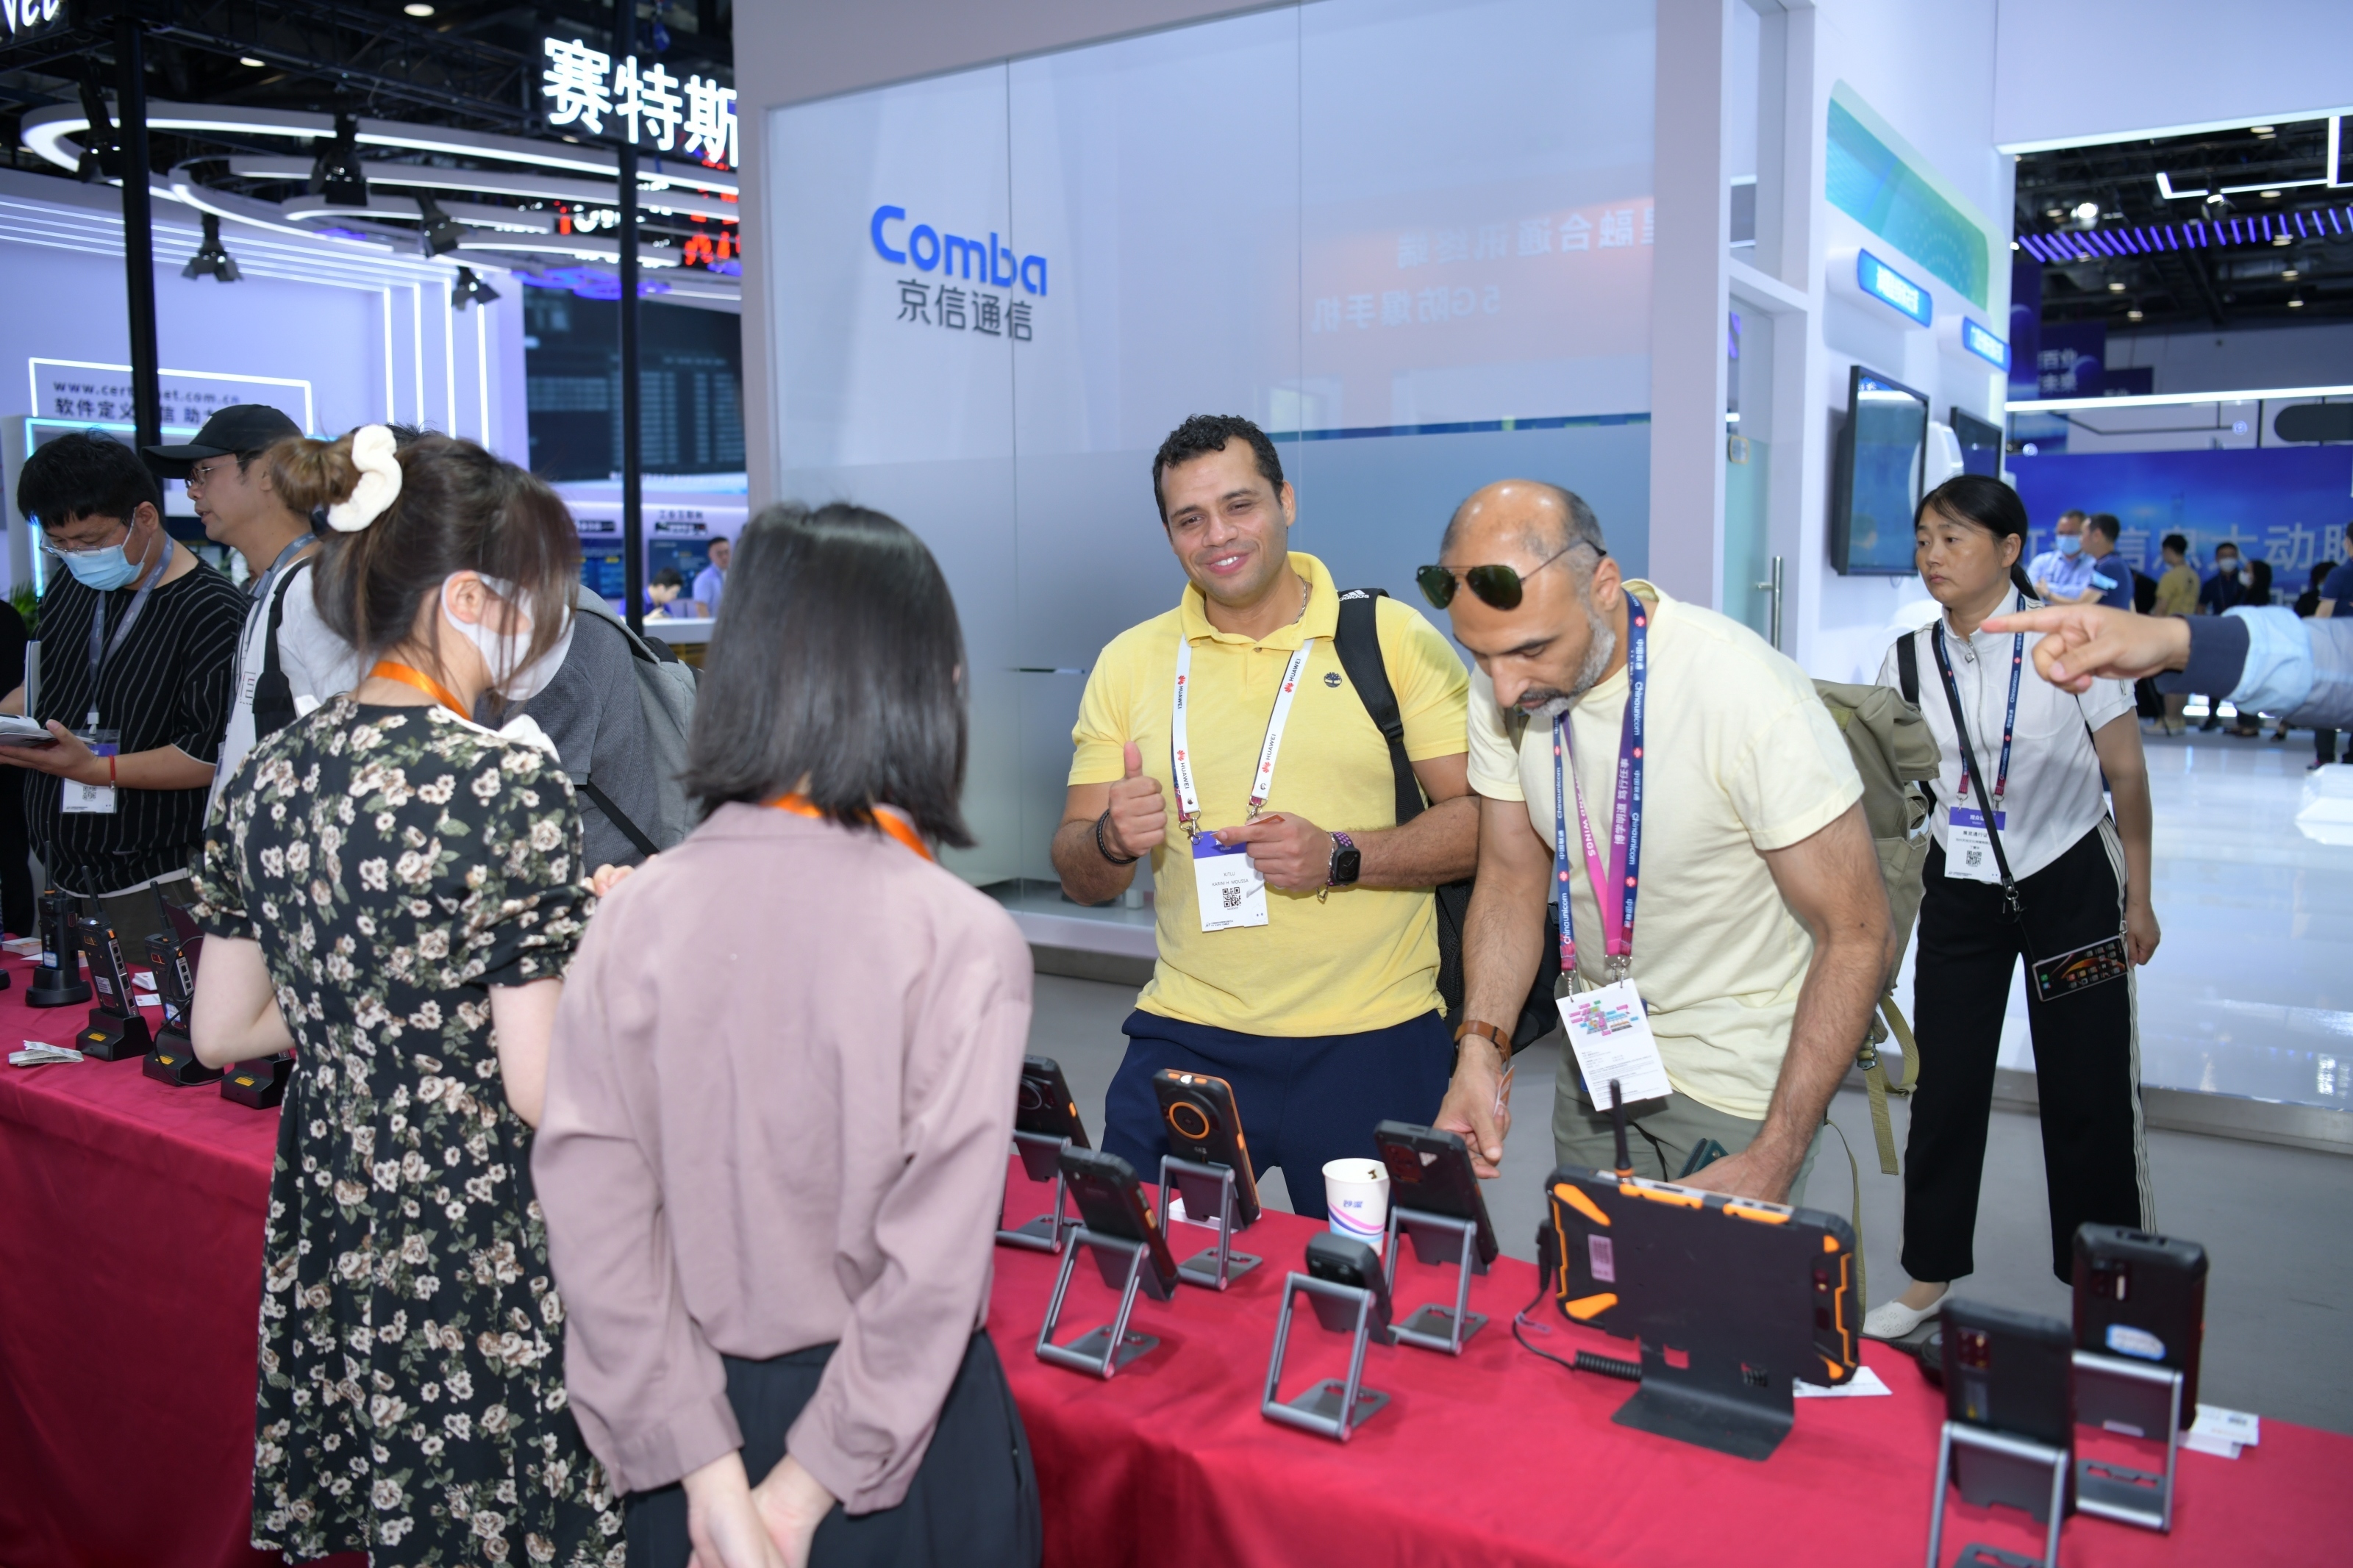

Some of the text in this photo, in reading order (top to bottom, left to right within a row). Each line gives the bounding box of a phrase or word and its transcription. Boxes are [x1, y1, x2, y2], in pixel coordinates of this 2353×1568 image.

[542, 37, 738, 168] 赛特斯
[871, 204, 1048, 296] Comba
[896, 279, 1032, 342] 京信通信
[53, 380, 240, 405] www.certet.com.cn
[54, 397, 176, 423] 软件定义信
[1339, 594, 1370, 602] adidas
[1289, 659, 1301, 681] HUAWEI
[1634, 681, 1643, 736] Chinaunicom
[1266, 734, 1276, 760] HUAWEI
[1181, 762, 1190, 789] HUAWEI
[1614, 758, 1629, 845] 博学明道 笃行任事
[1583, 819, 1596, 857] WINGS
[1629, 812, 1640, 865] Chinaunicom
[1561, 892, 1572, 945] Chinaunicom
